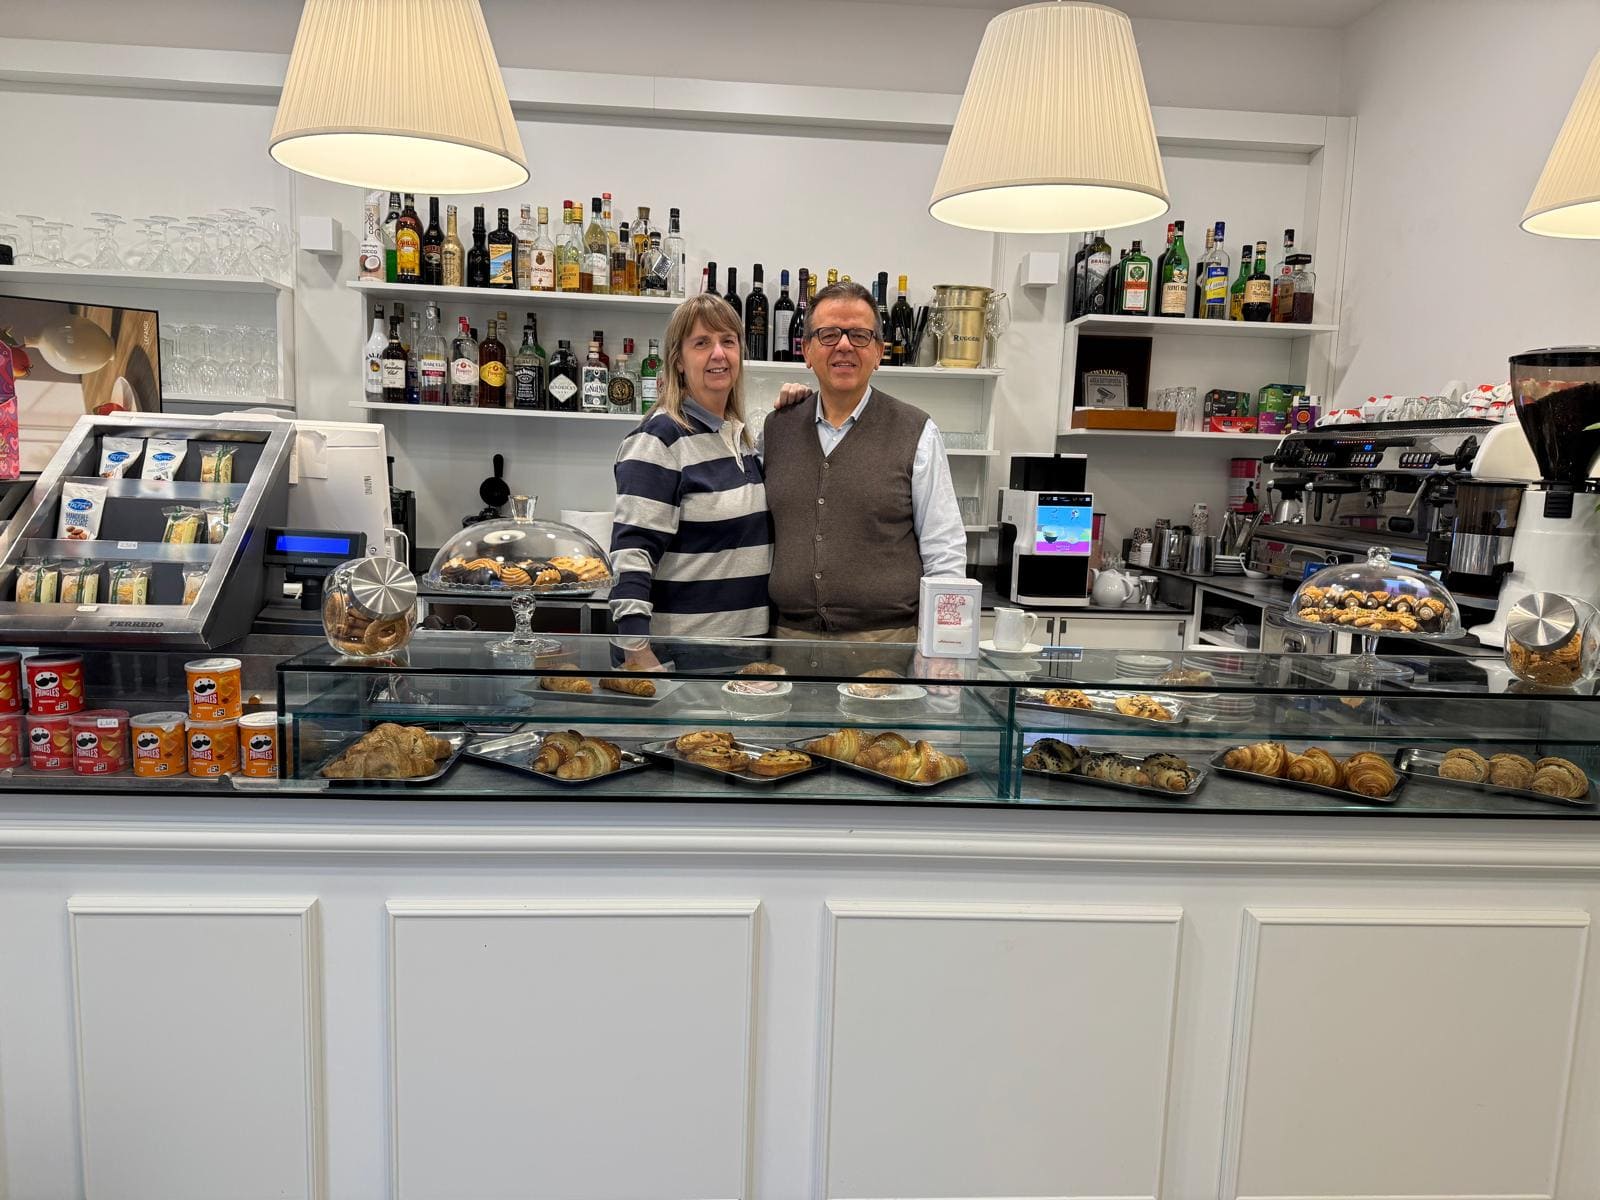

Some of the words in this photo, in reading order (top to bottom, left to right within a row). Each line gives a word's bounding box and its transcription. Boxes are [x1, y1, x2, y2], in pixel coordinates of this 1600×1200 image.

[35, 688, 59, 697] PRINGLES
[194, 693, 218, 705] PRINGLES
[76, 748, 98, 758] PRINGLES
[137, 748, 160, 759] PRINGLES
[191, 749, 211, 760] PRINGLES
[249, 749, 272, 760] PRINGLES
